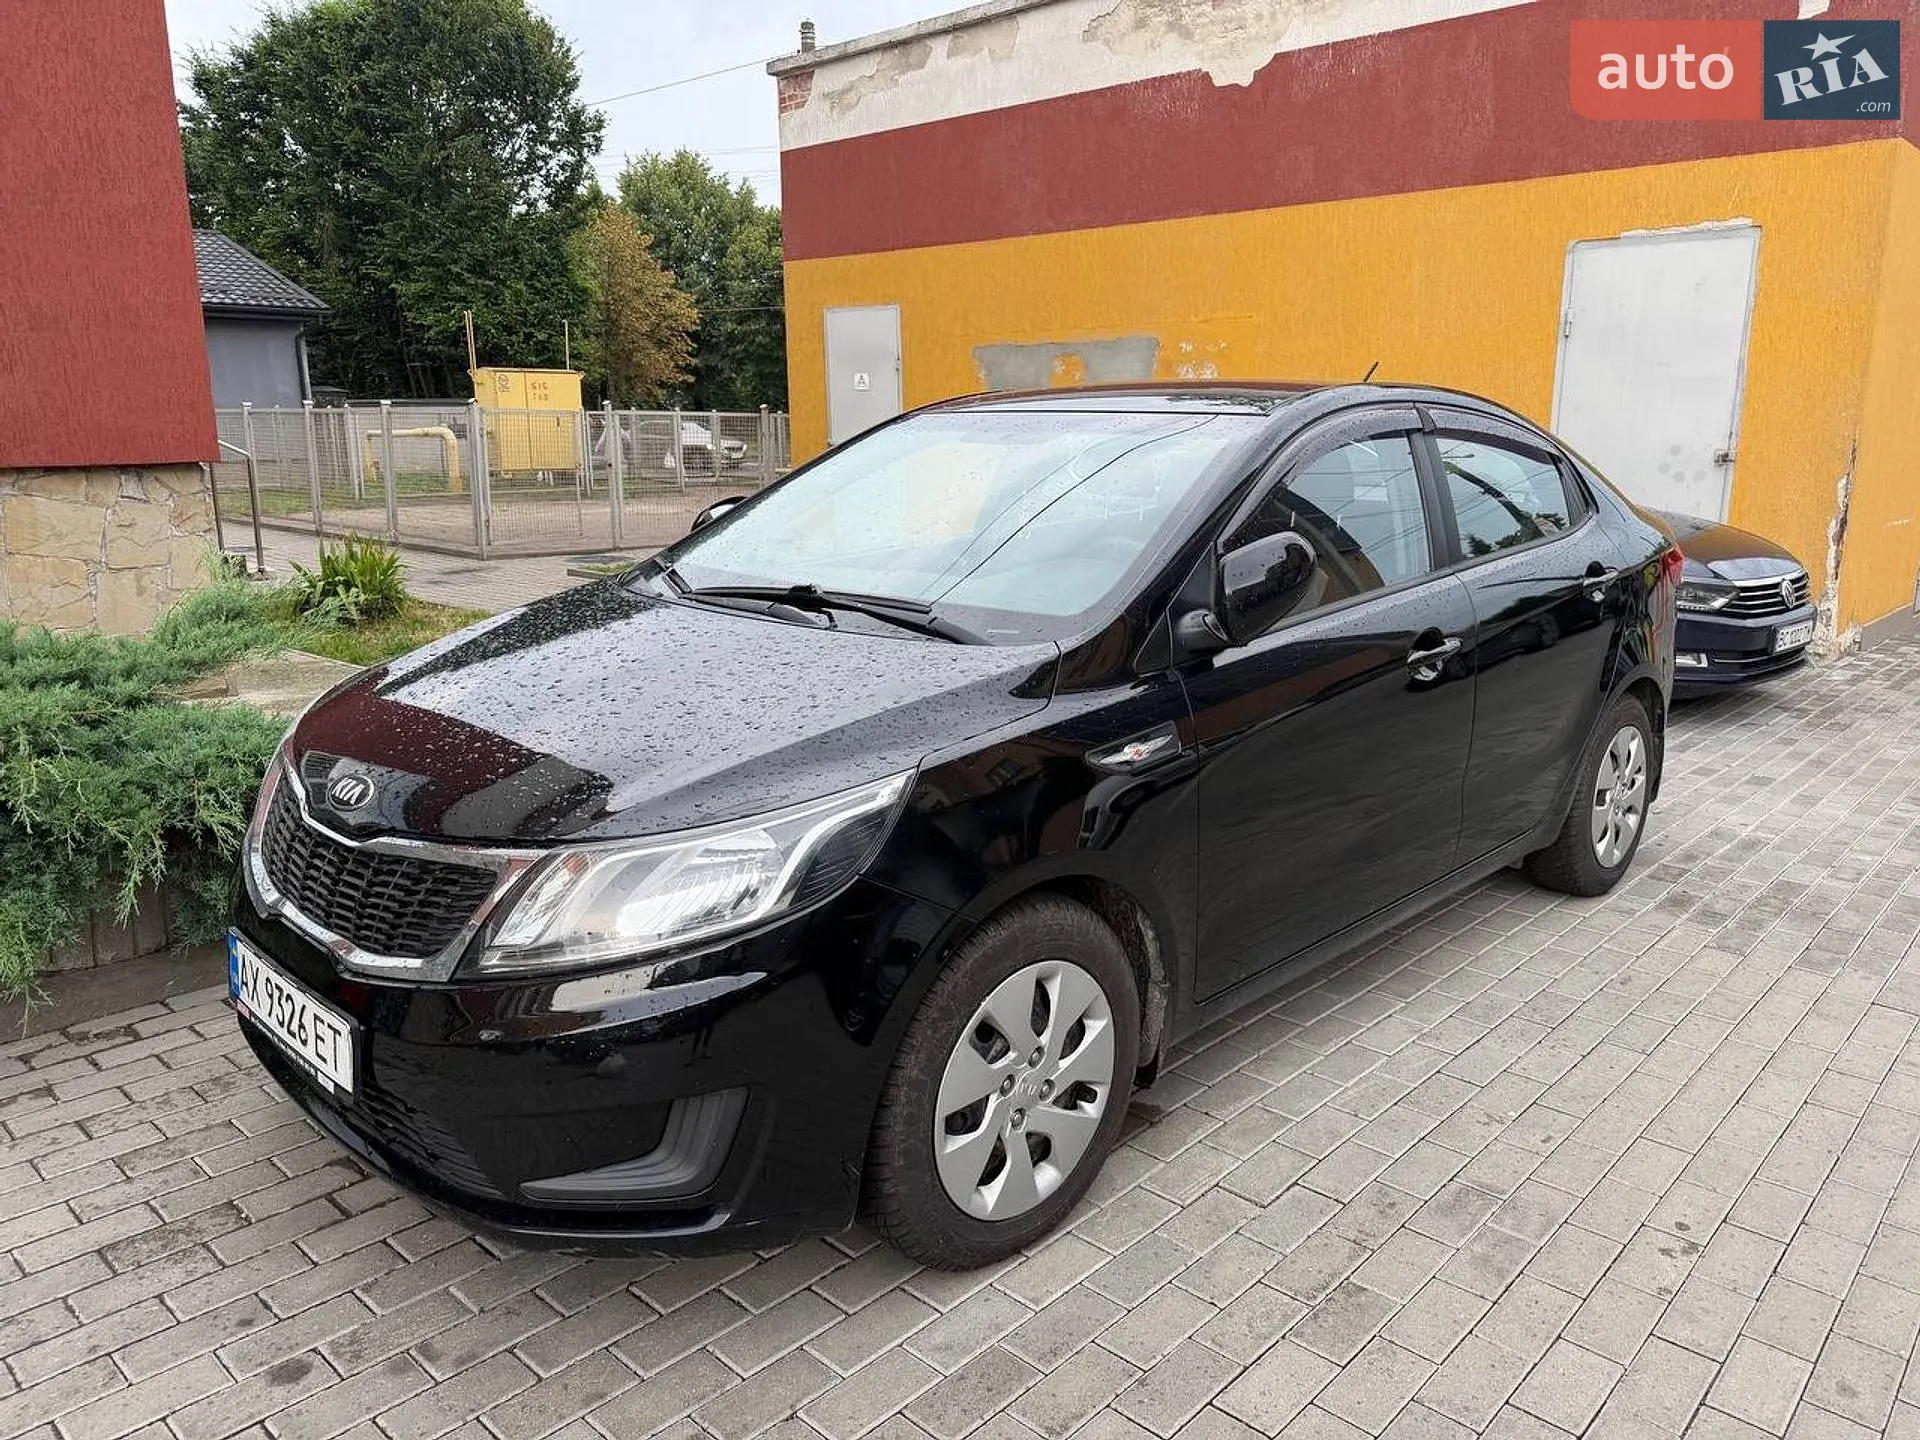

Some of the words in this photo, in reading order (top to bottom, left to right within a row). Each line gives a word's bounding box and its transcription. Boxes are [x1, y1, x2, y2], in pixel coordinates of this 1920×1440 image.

[240, 954, 262, 1009] AX
[265, 976, 309, 1047] 9326
[313, 1012, 342, 1073] ET
